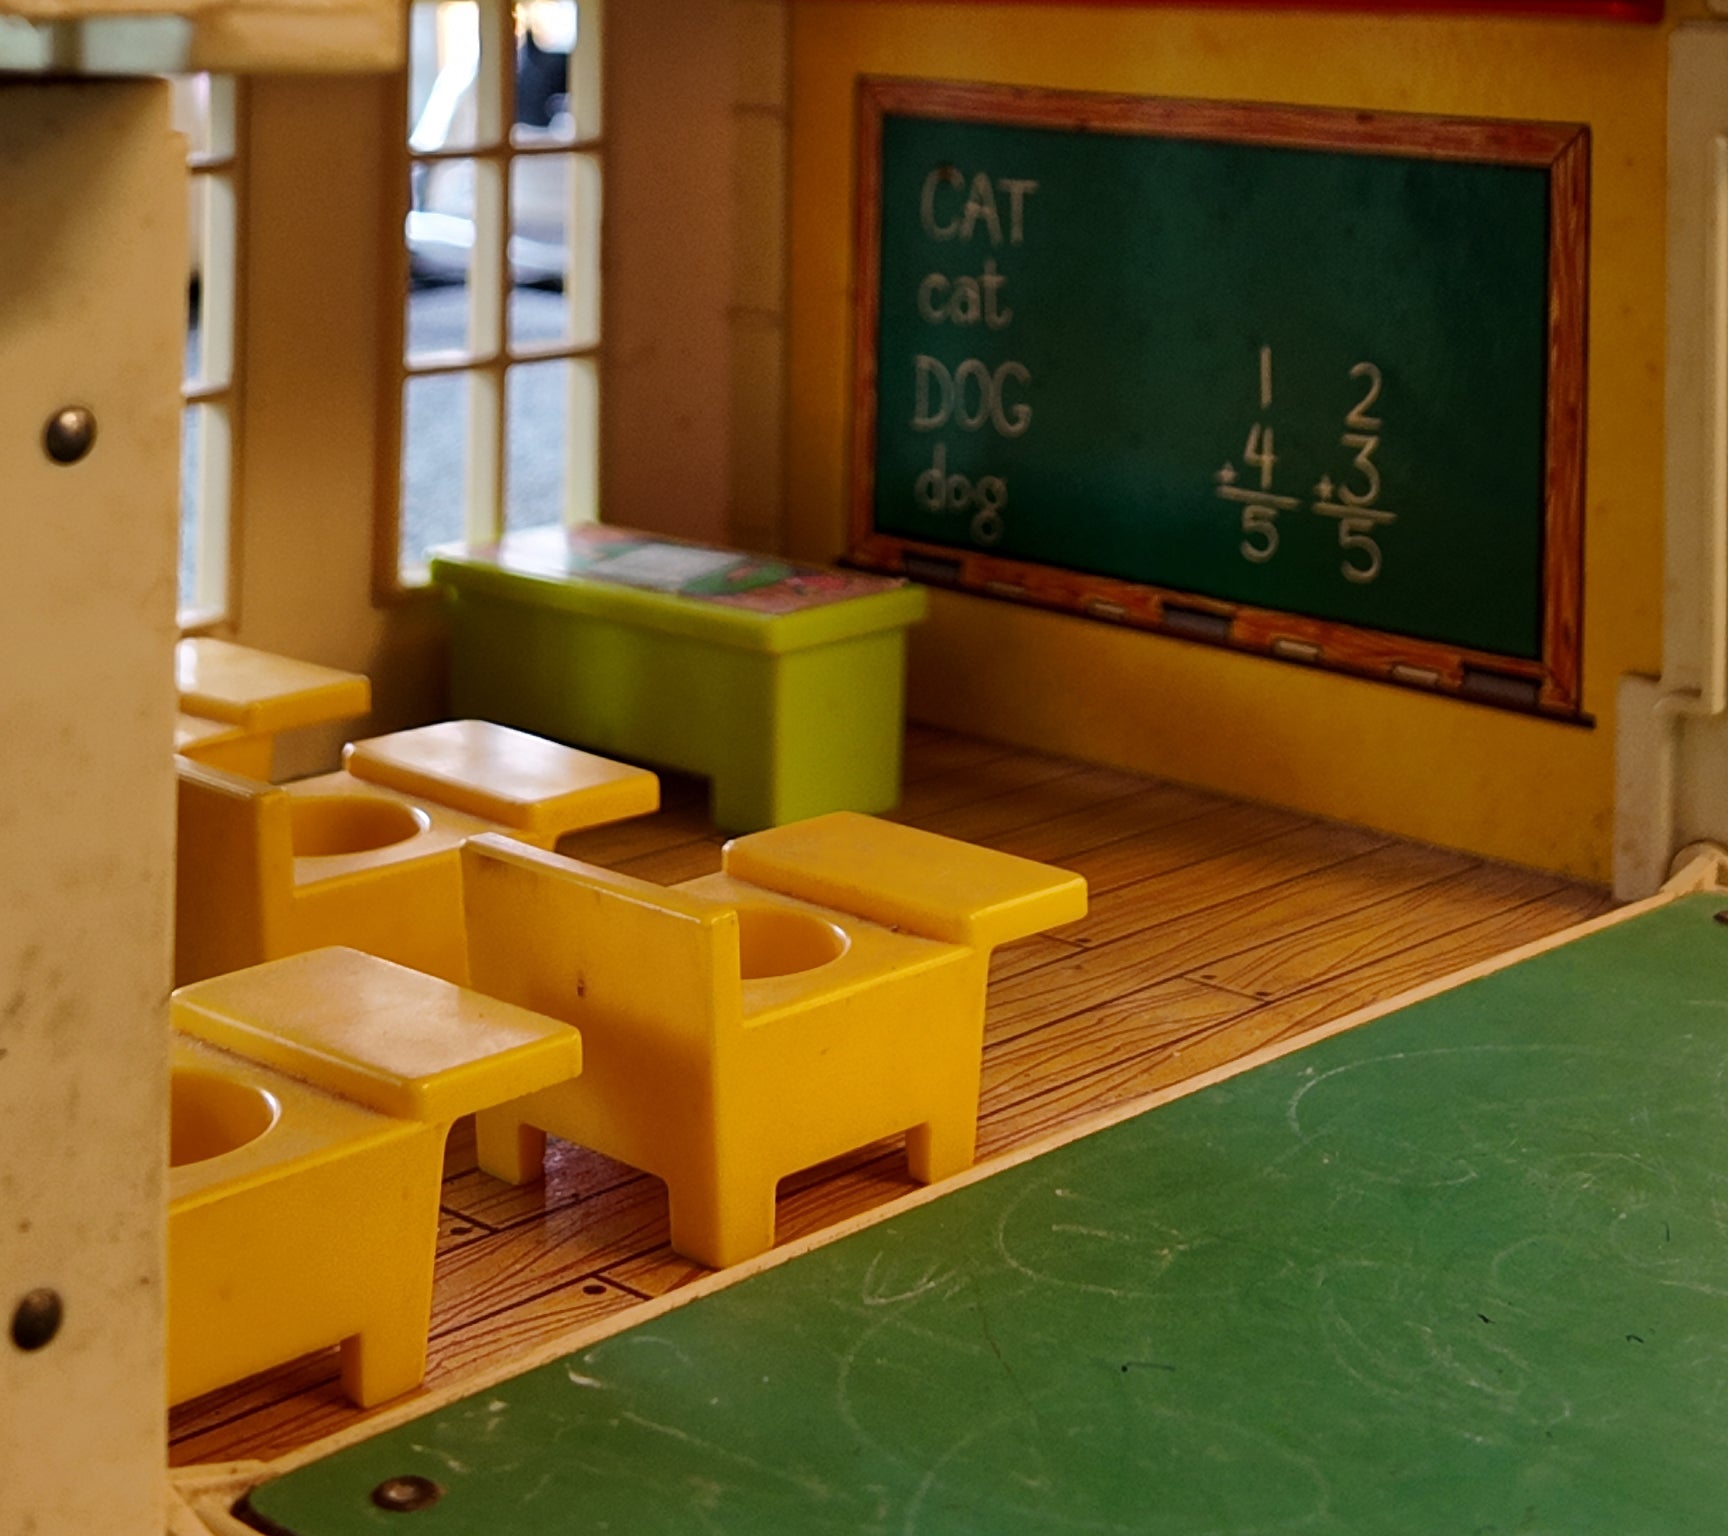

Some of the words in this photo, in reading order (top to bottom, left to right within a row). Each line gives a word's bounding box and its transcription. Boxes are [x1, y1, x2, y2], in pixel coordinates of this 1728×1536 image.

[920, 166, 1037, 244] CAT
[917, 260, 1012, 328] cat
[912, 355, 1031, 436] DOG
[1345, 361, 1382, 429] 2
[915, 443, 1008, 544] dog
[1240, 505, 1279, 563] 5
[1339, 518, 1382, 583] 5
